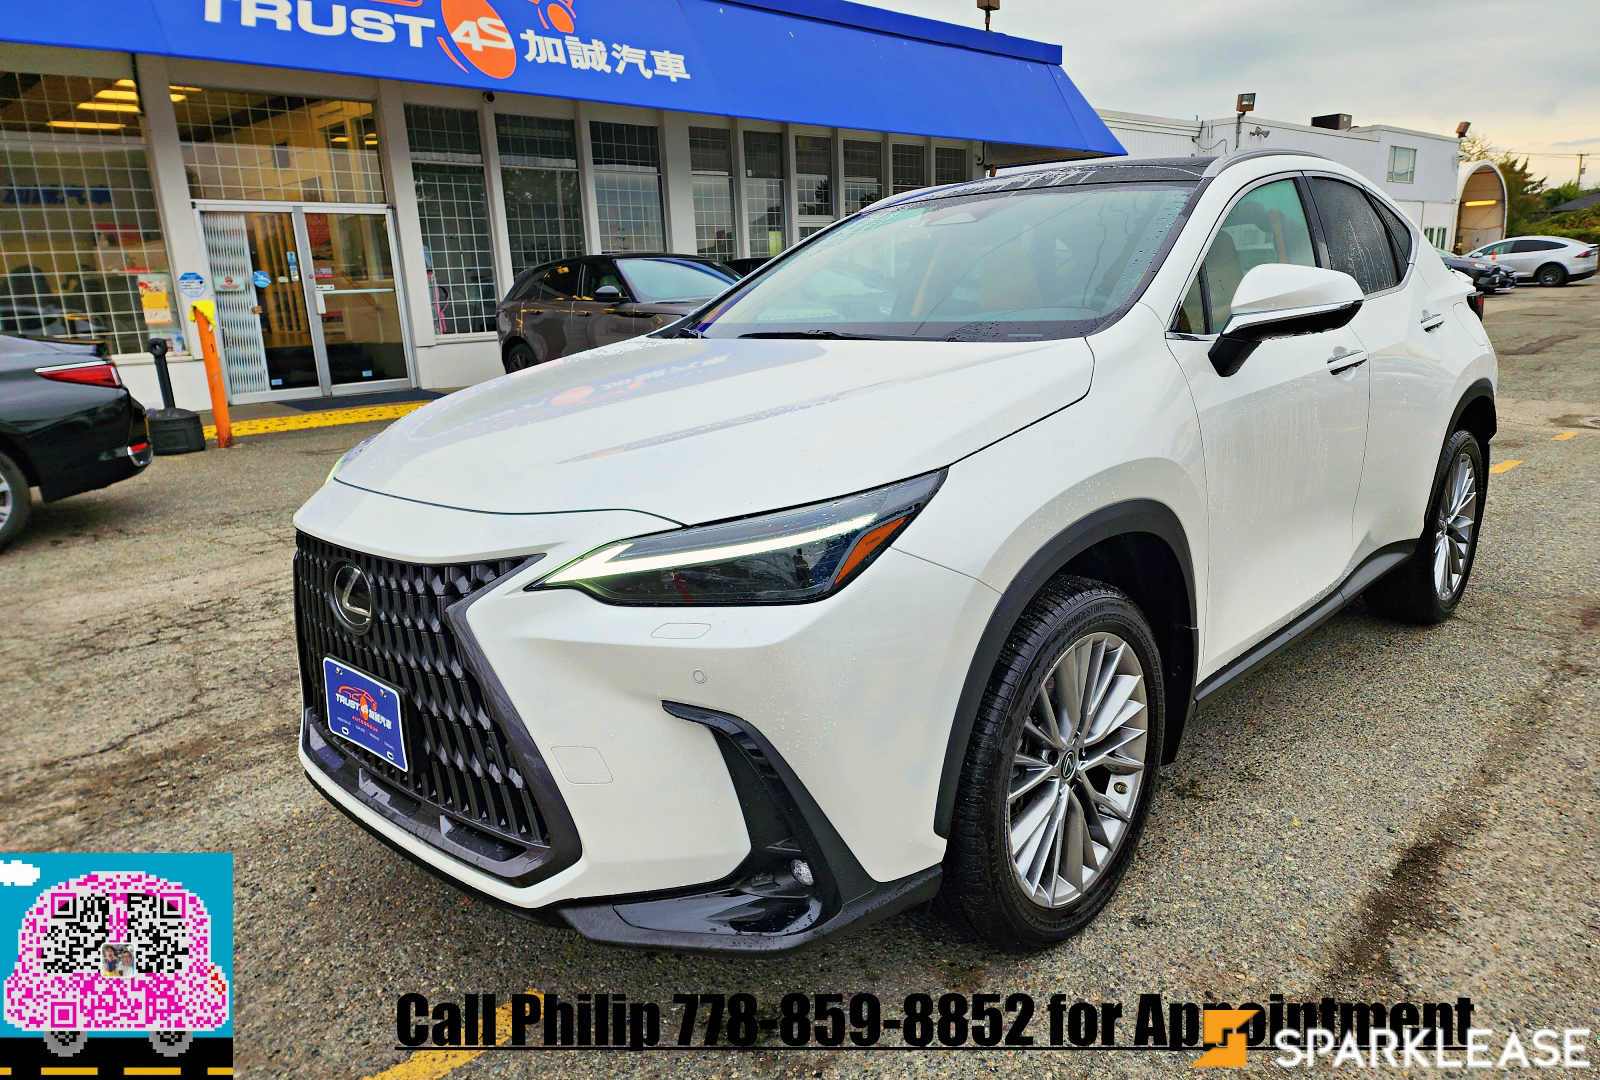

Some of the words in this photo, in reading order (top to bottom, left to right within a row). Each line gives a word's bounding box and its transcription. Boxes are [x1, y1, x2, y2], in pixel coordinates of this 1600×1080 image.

[203, 0, 436, 48] TRUST
[451, 16, 515, 52] 4S
[520, 29, 691, 82] 加誠汽車
